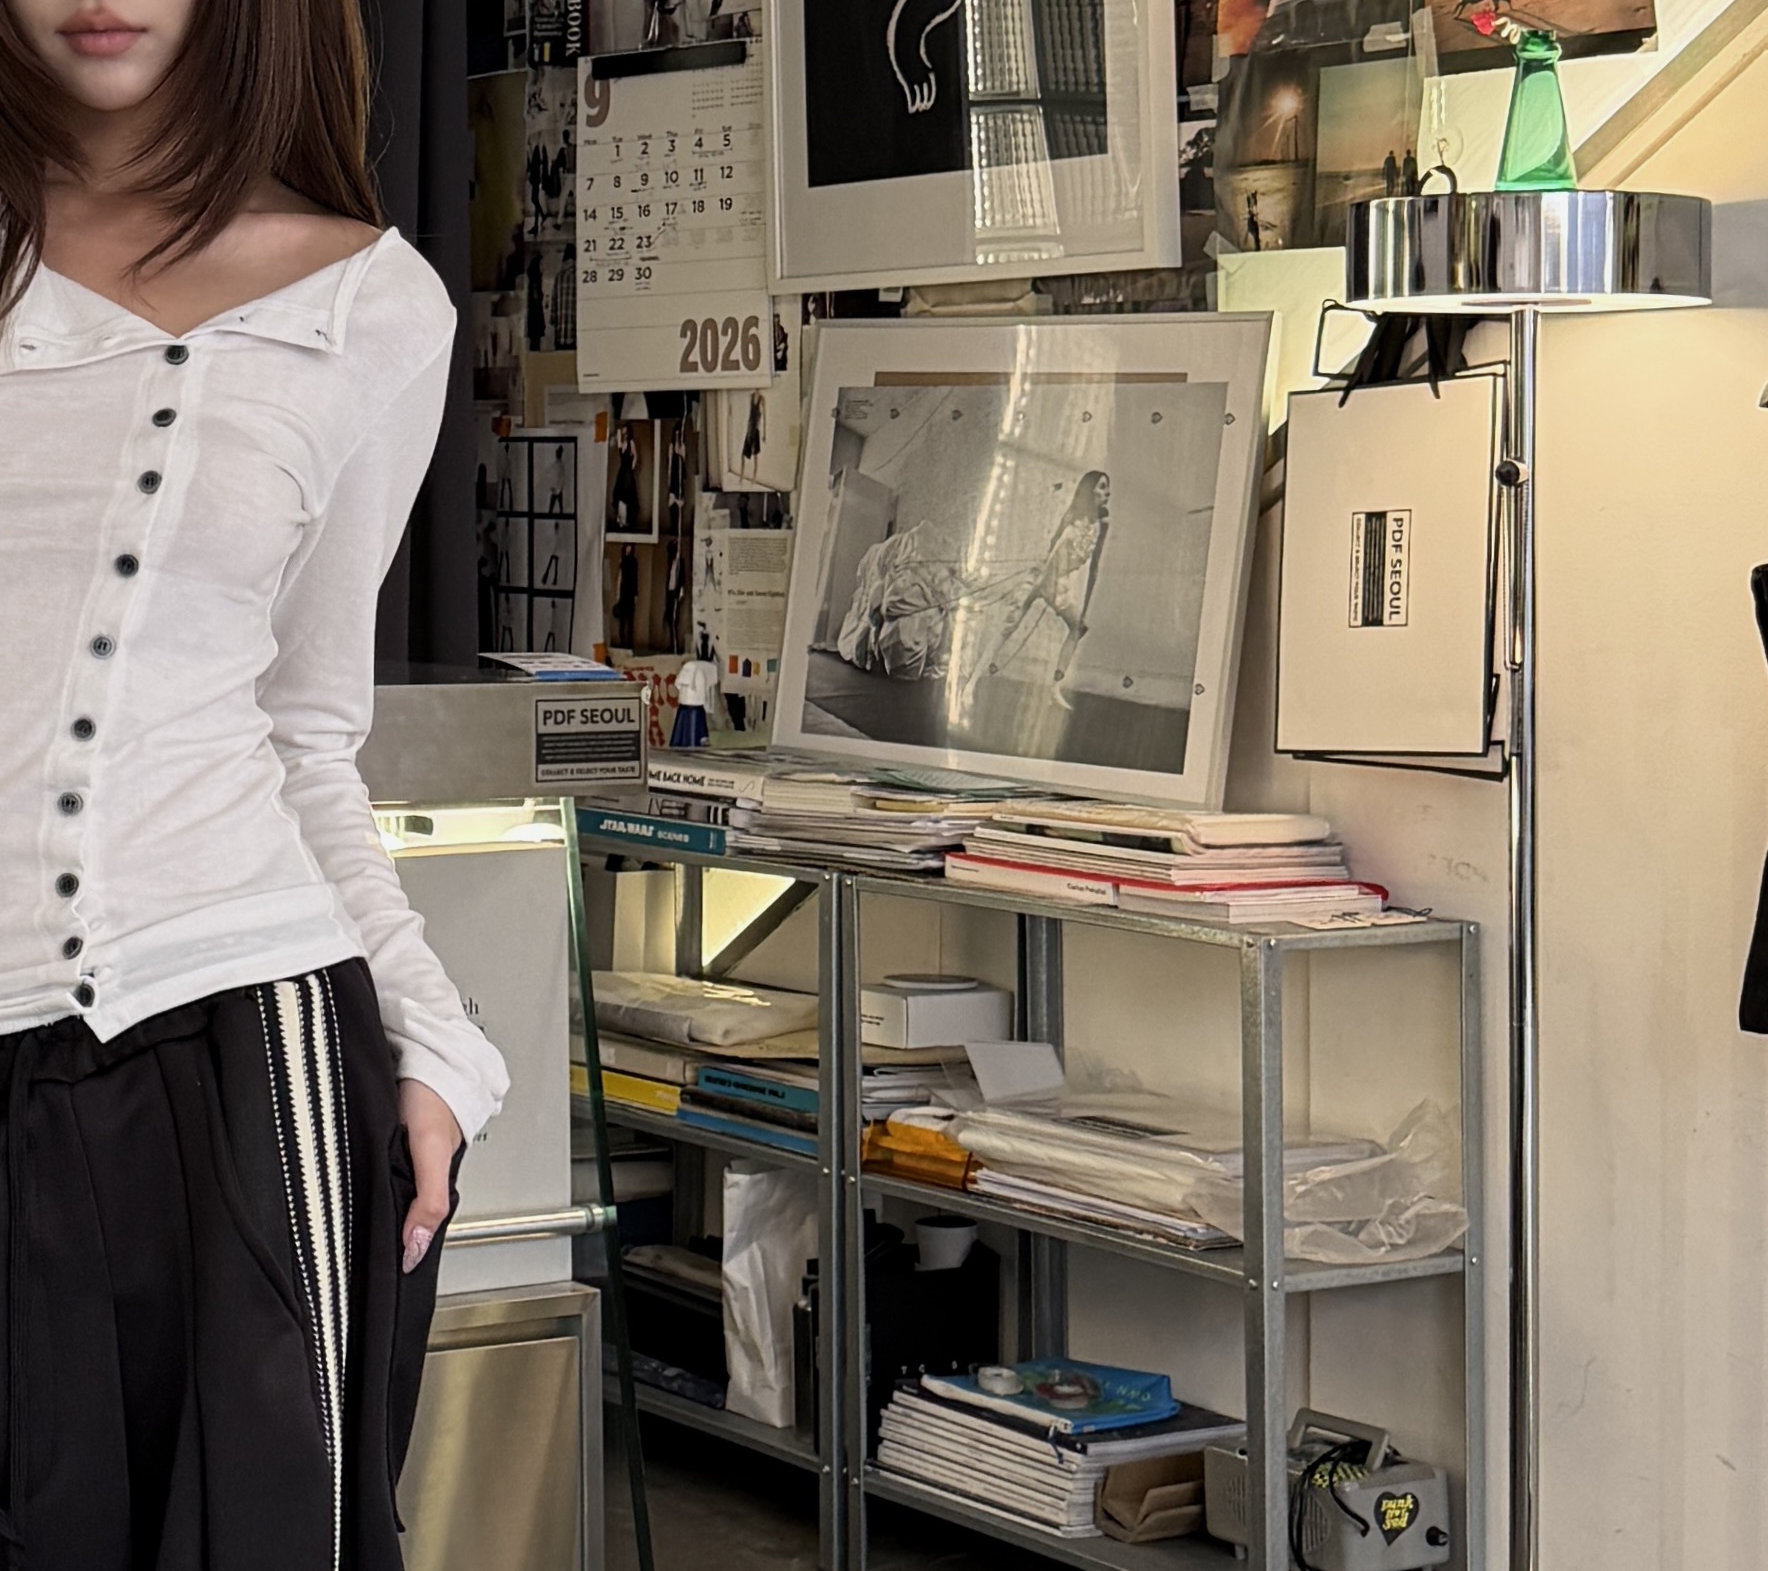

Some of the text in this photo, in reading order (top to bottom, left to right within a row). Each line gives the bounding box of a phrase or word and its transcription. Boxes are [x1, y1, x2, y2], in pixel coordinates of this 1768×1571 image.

[584, 77, 611, 128] 9
[615, 133, 732, 157] 1 2 3 4 5
[585, 166, 734, 191] 7 8 9 10 11 12
[583, 197, 733, 222] 14 15 16 17 18 19
[583, 235, 652, 253] 21 22 23
[582, 266, 652, 283] 28 29 30
[679, 315, 761, 373] 2026
[1389, 517, 1404, 621] PDF SEOUL
[543, 708, 635, 726] PDF SEOUL
